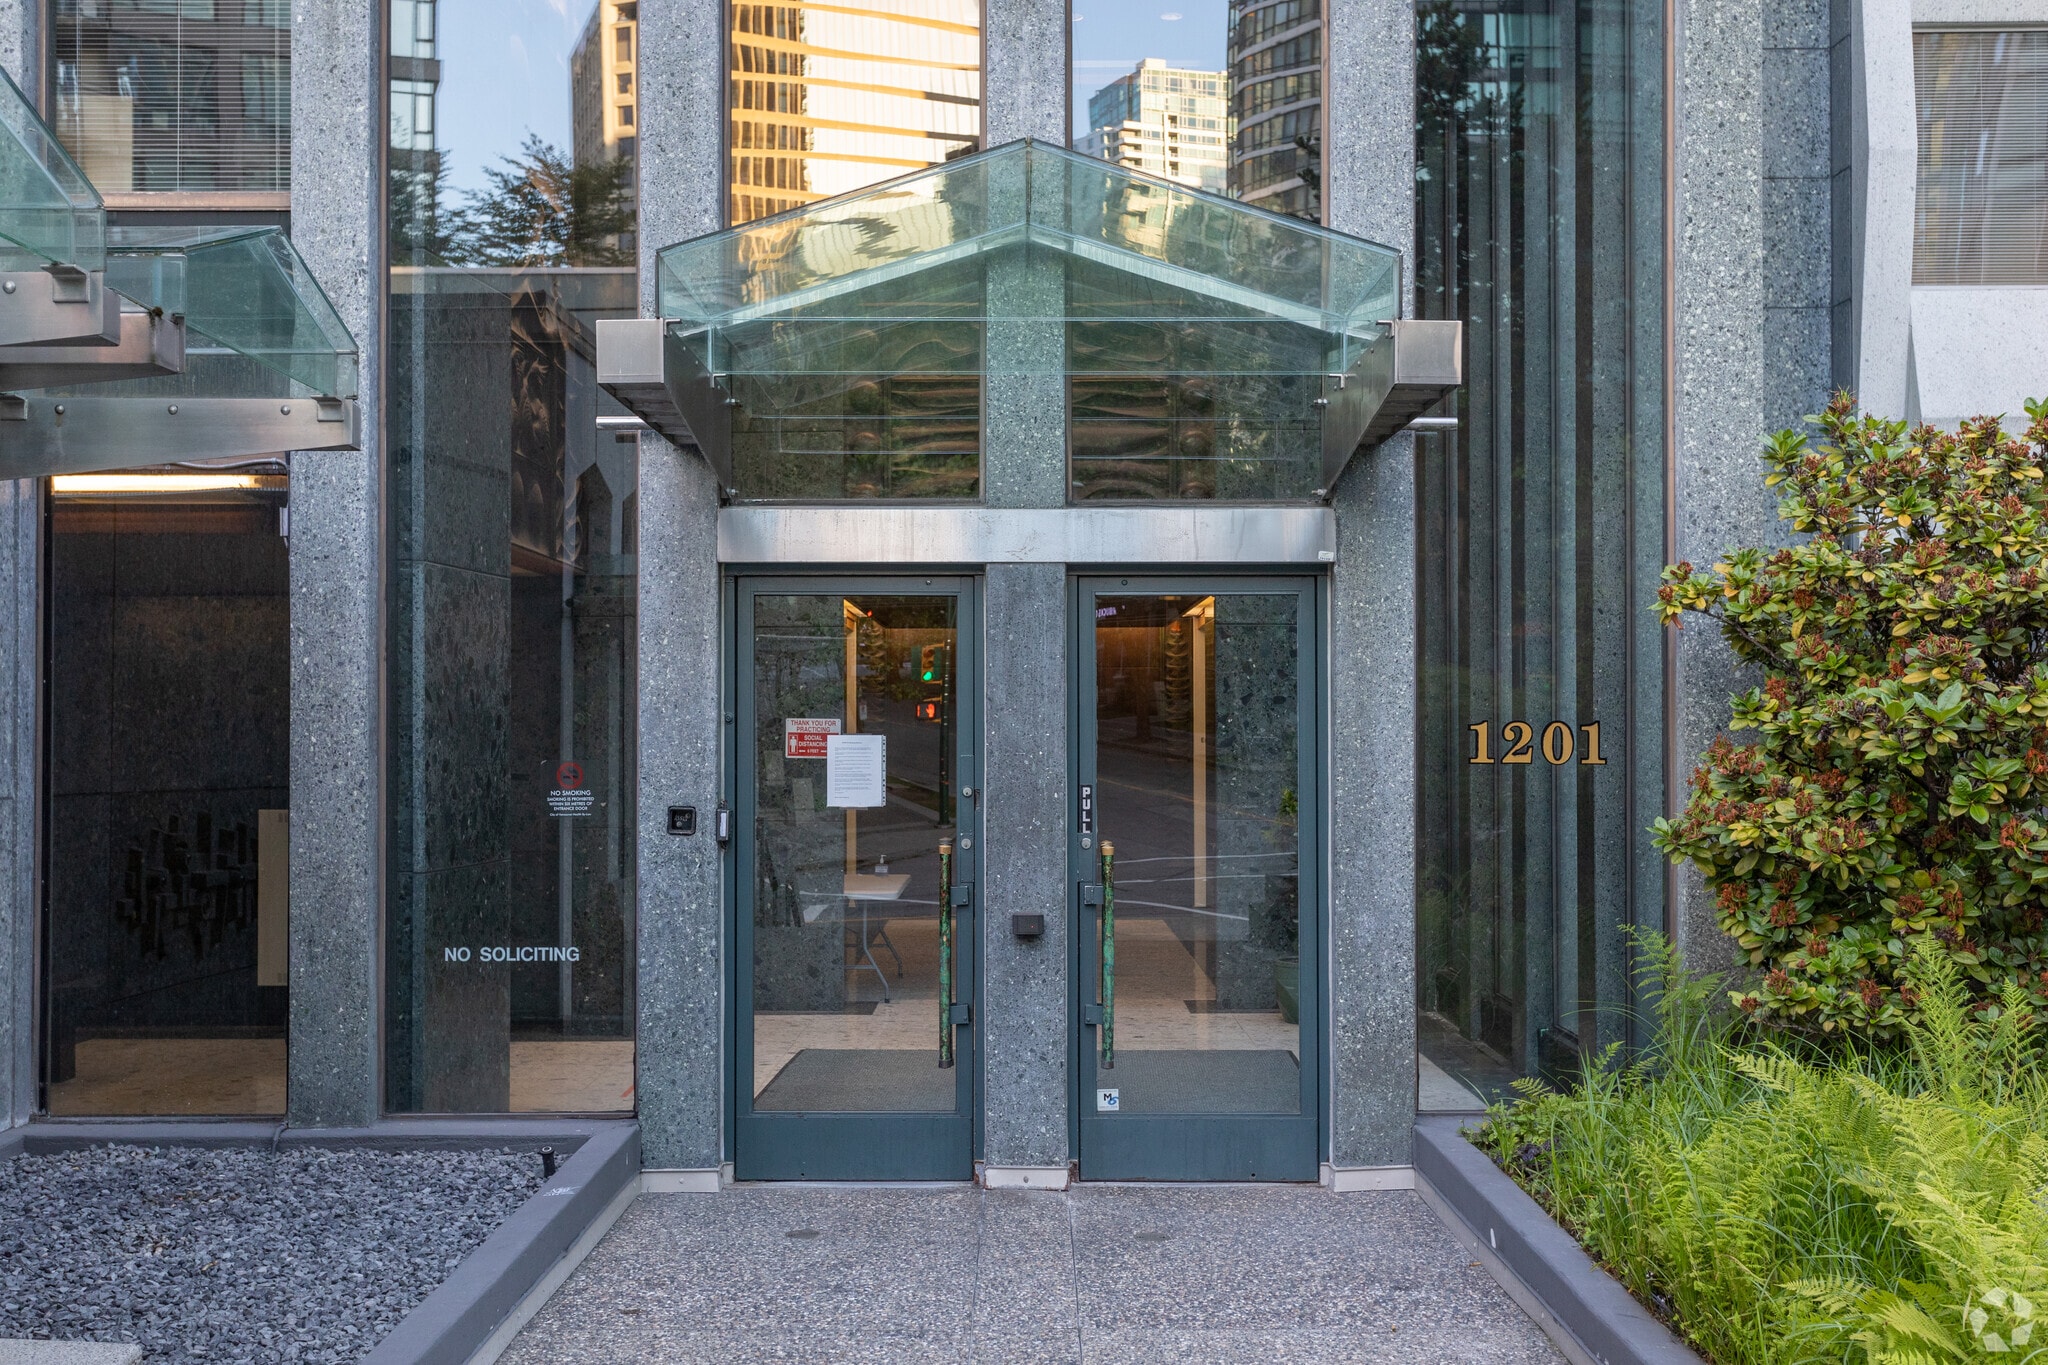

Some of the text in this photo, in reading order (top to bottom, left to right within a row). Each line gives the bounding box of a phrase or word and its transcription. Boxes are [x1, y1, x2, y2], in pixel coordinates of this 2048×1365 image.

[1468, 720, 1607, 765] 1201
[1082, 787, 1091, 833] PULL
[444, 946, 580, 962] NO SOLICITING
